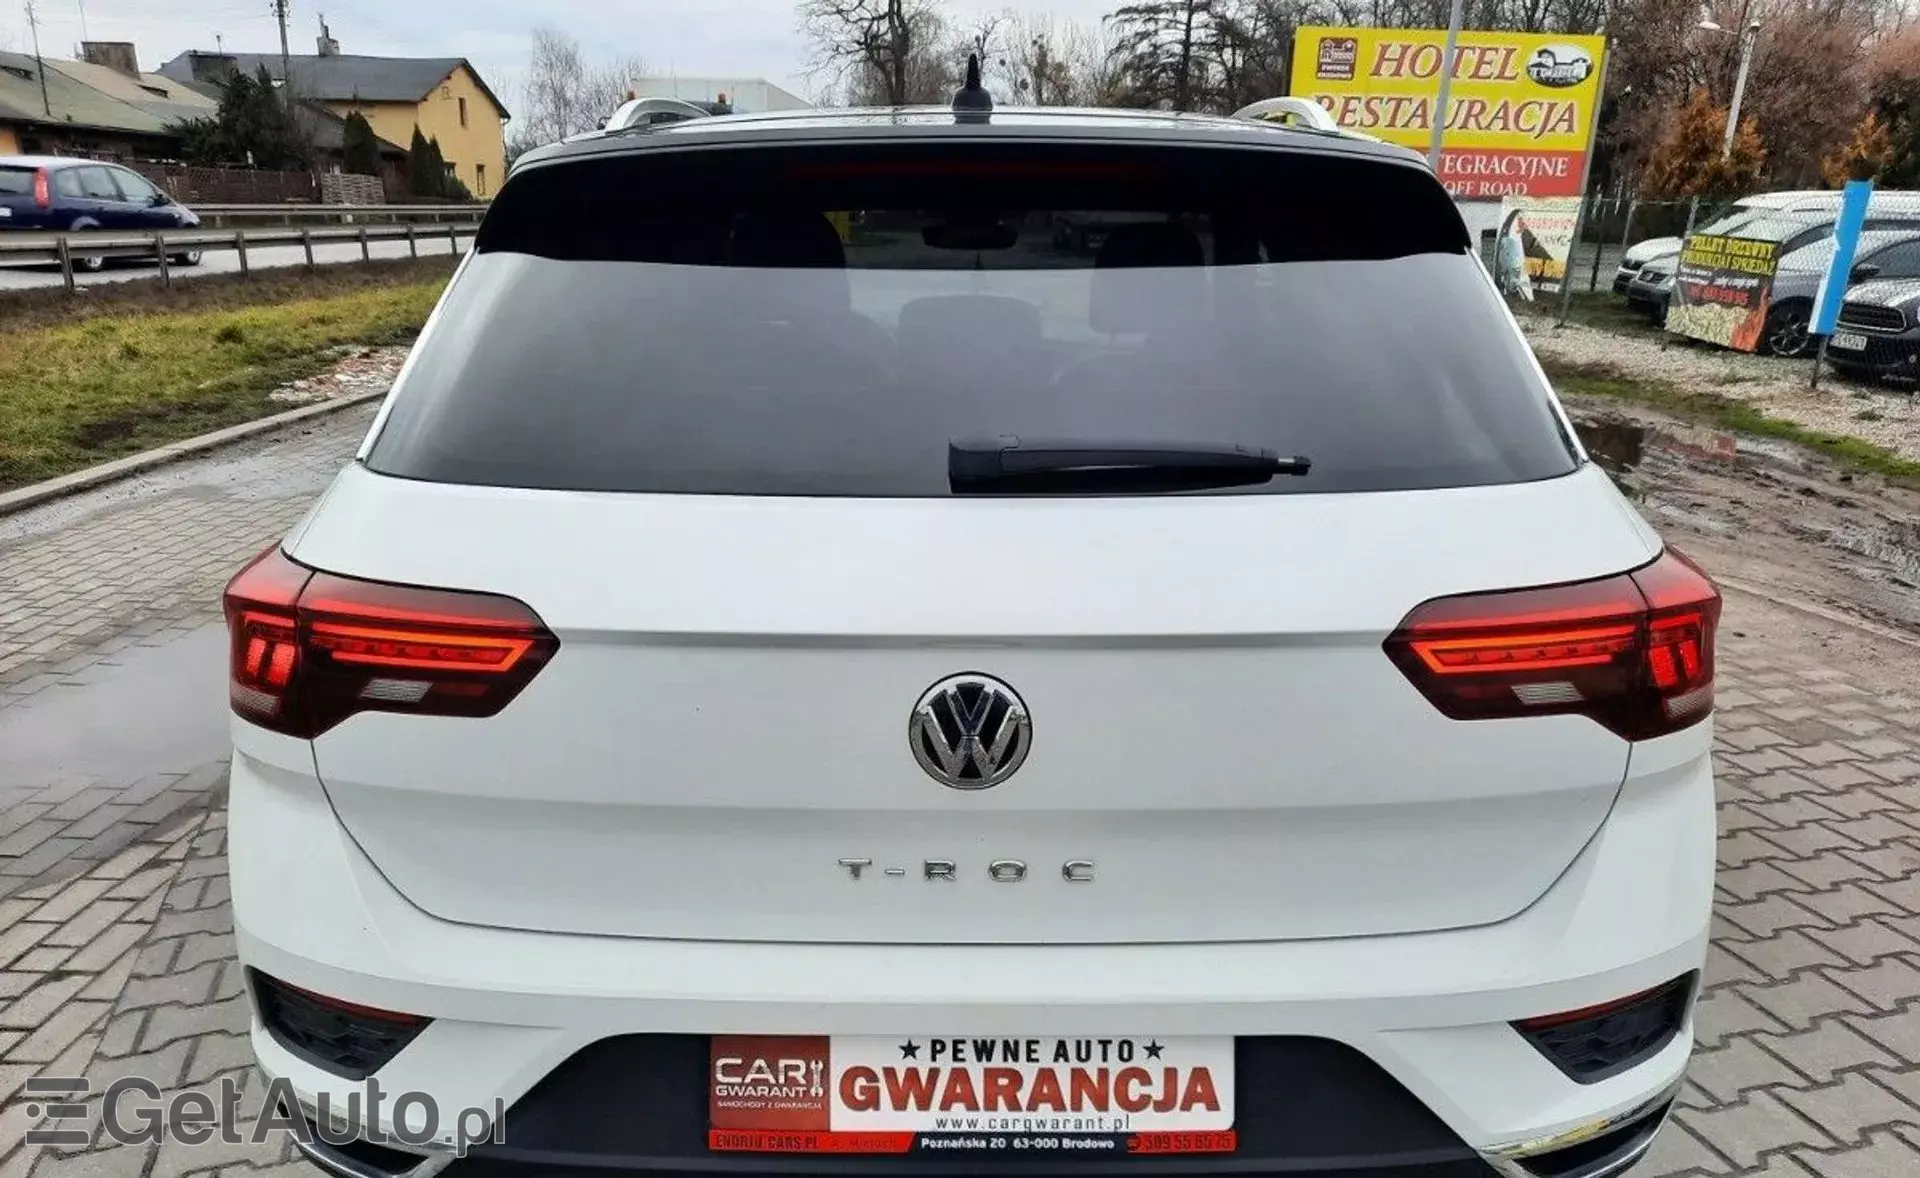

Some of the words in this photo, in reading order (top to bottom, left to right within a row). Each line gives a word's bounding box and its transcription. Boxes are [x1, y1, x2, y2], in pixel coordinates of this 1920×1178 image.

[1369, 43, 1519, 81] HOTEL
[1443, 180, 1475, 196] OFF
[1478, 181, 1528, 197] ROAD
[930, 1039, 1040, 1063] PEWNE
[1052, 1039, 1135, 1063] AUTO
[715, 1057, 807, 1085] CAR
[715, 1085, 808, 1098] GWARANT
[838, 1065, 1222, 1114] GWARANCJA
[935, 1113, 1131, 1132] www.cargwarant.pl
[920, 1135, 987, 1150] Poznańska
[989, 1137, 1006, 1149] 20
[1012, 1136, 1058, 1149] 63-000
[1062, 1137, 1115, 1149] Brodowo
